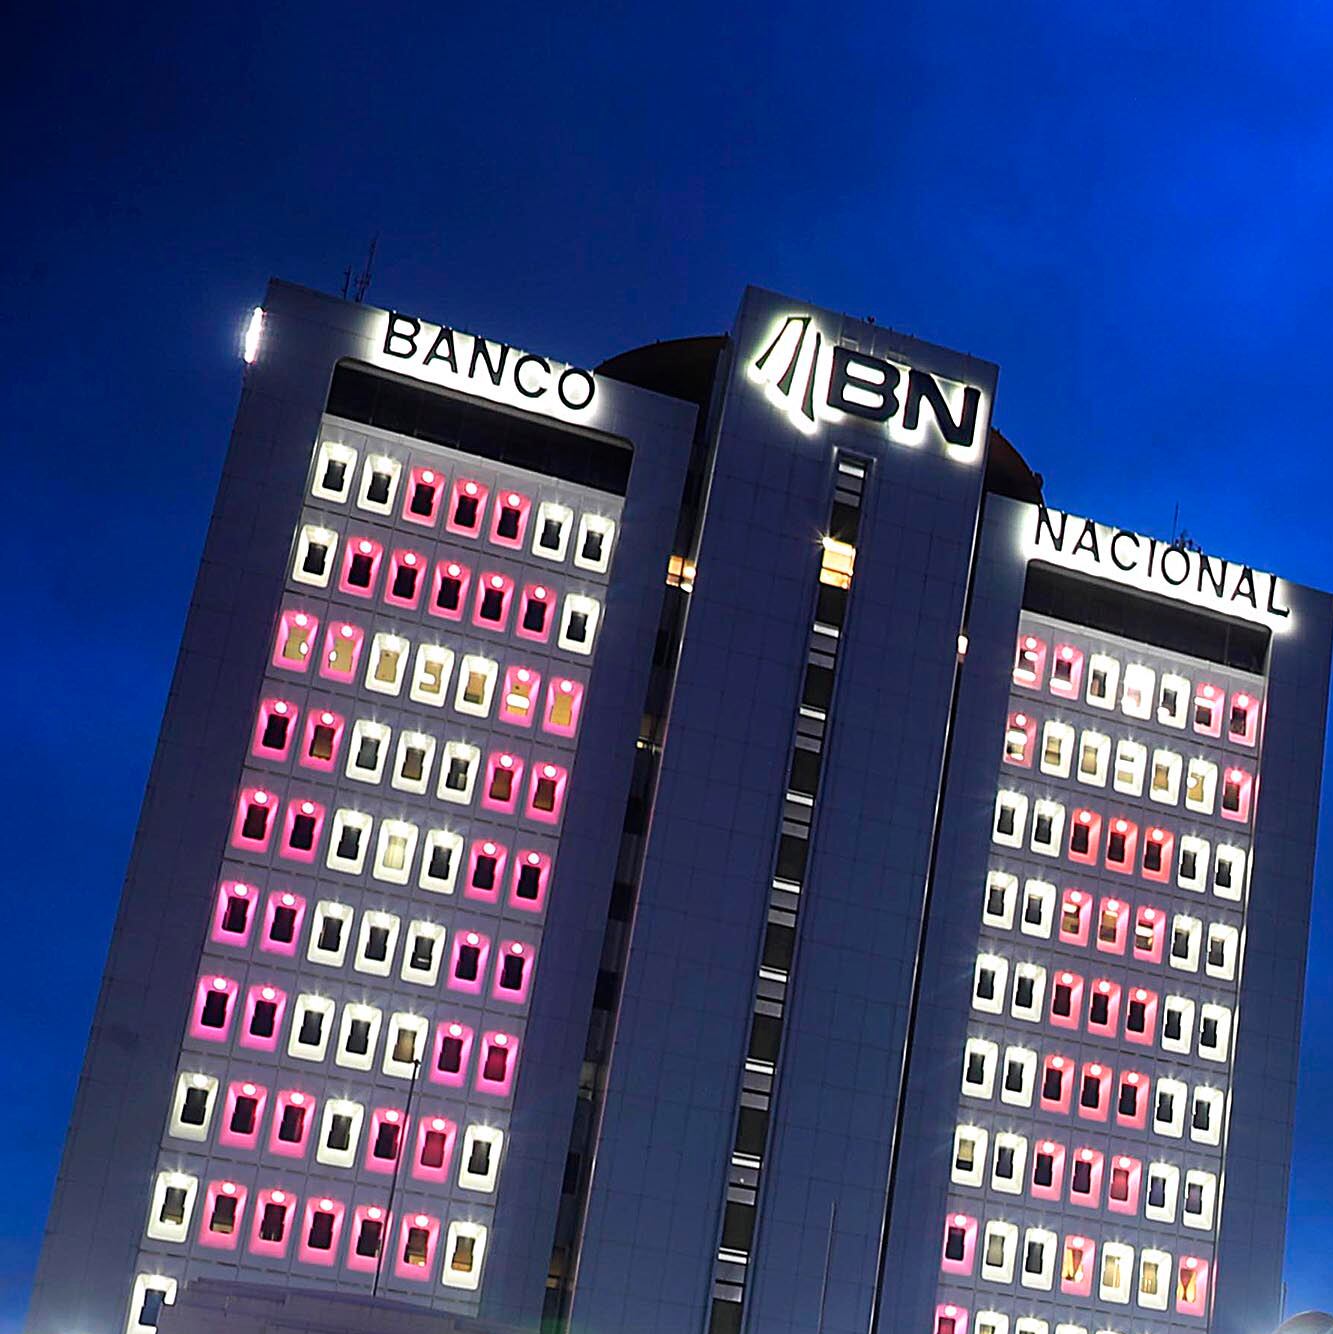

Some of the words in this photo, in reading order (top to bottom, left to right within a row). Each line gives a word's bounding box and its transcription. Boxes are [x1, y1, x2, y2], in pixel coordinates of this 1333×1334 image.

[383, 311, 596, 410] BANCO
[826, 346, 982, 448] BN
[1034, 503, 1291, 618] NACIONAL
